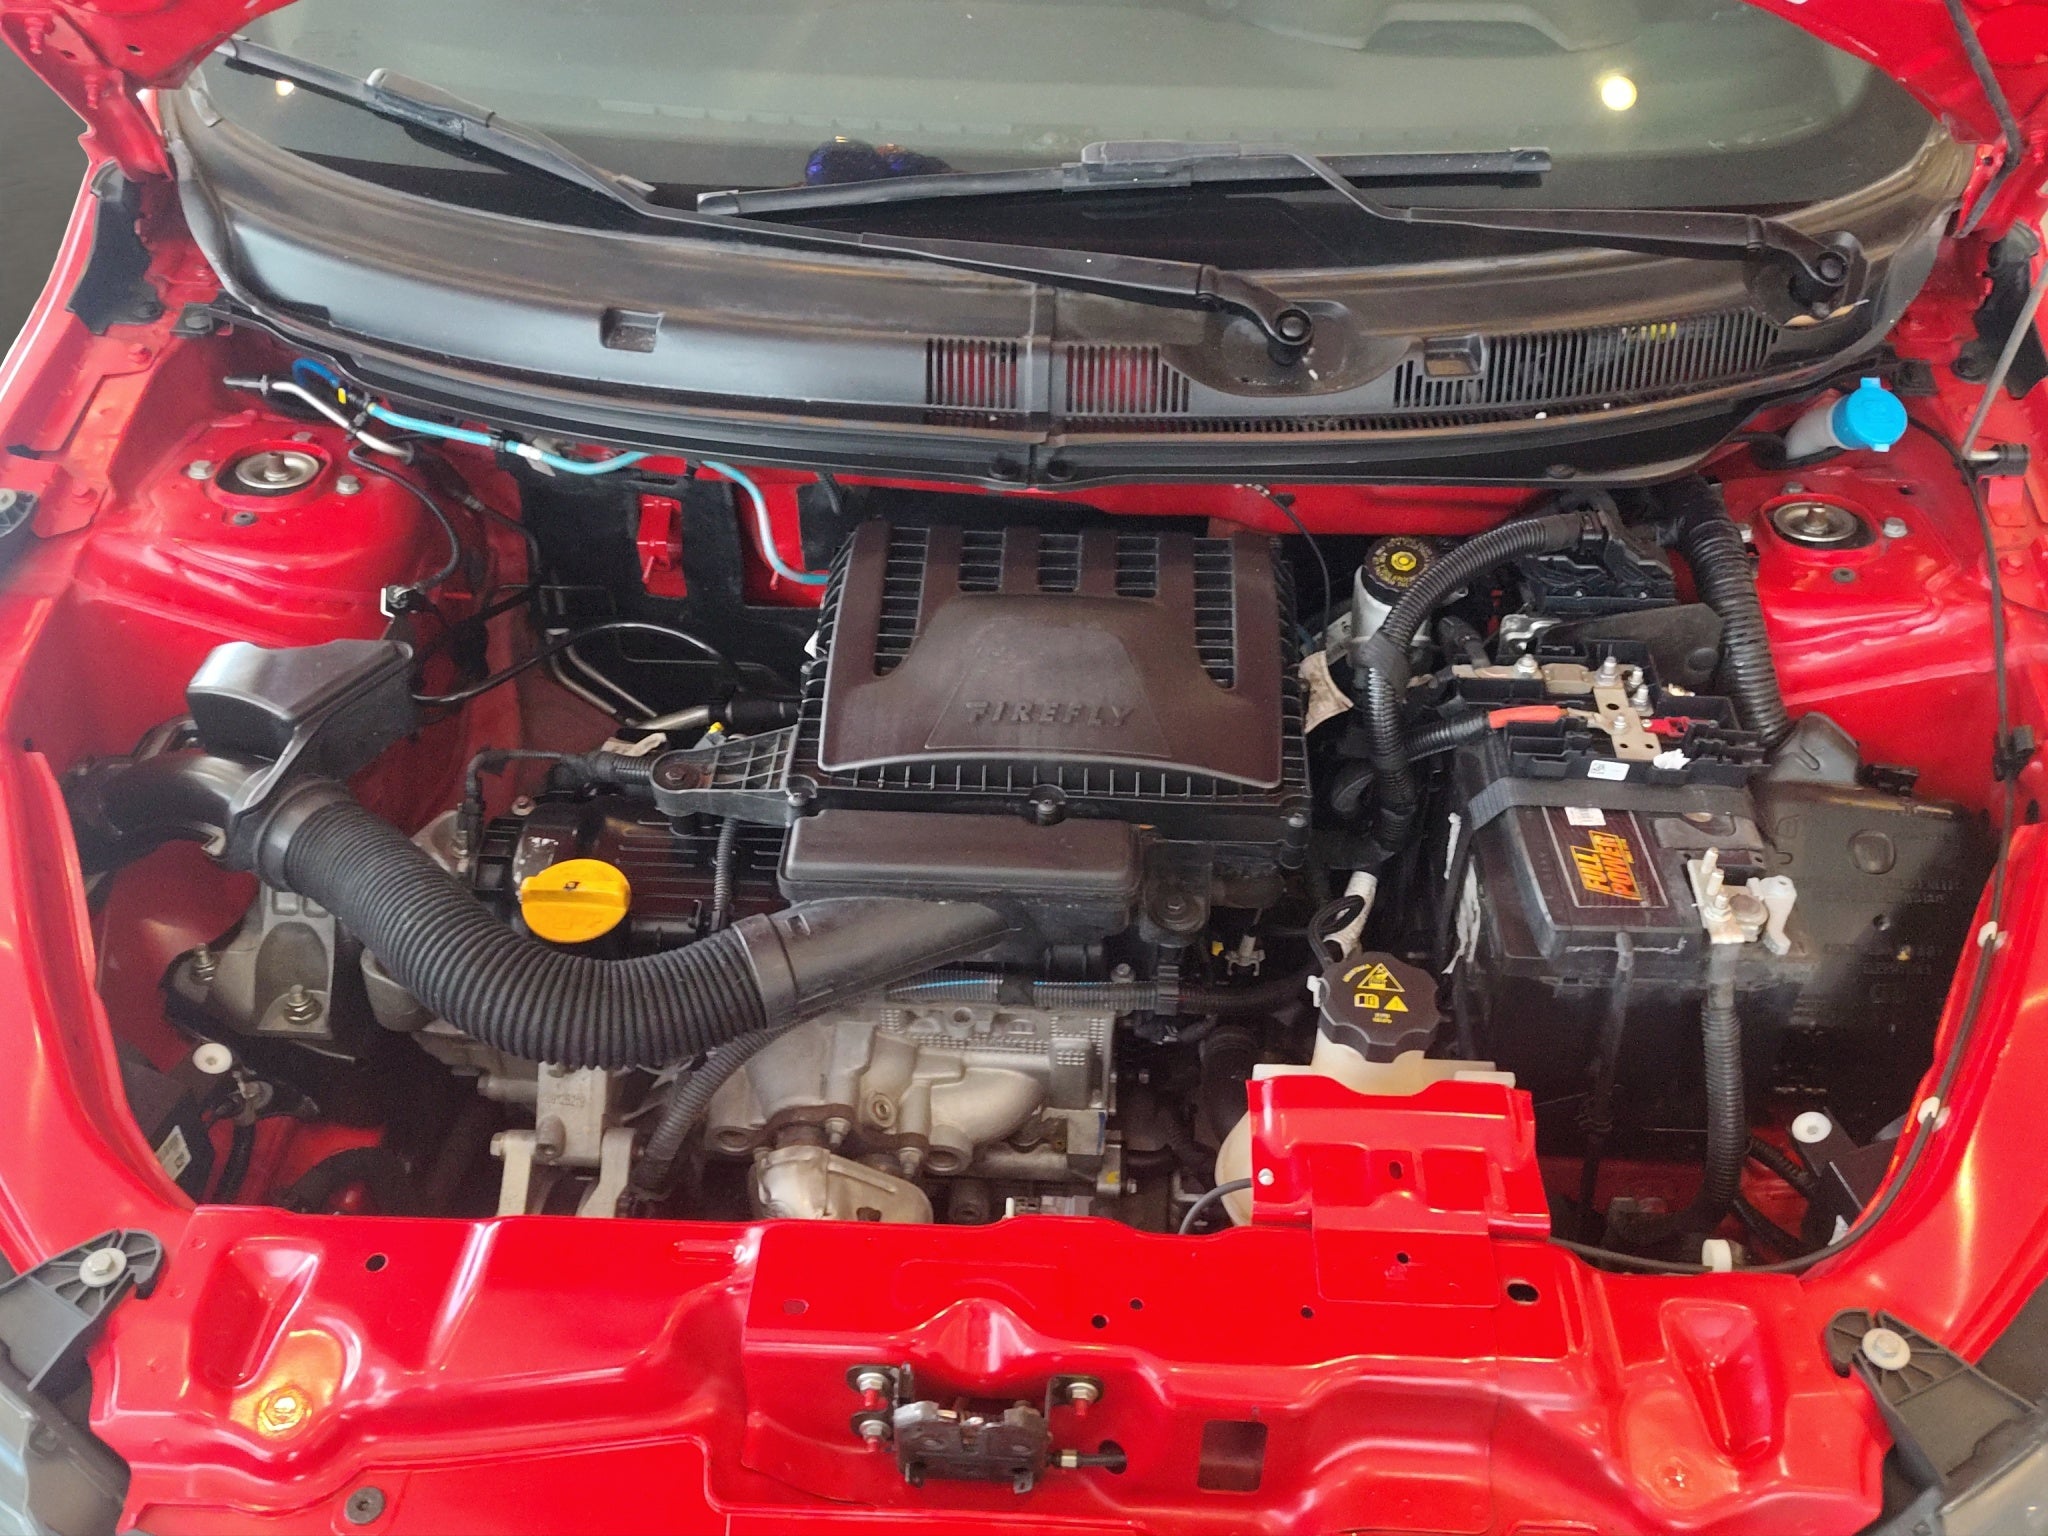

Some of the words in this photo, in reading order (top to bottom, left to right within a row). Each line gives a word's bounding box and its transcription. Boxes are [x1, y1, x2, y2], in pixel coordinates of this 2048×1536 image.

[965, 700, 1135, 727] FIREFLY
[1575, 852, 1612, 892] FULL
[1591, 834, 1637, 897] POWER
